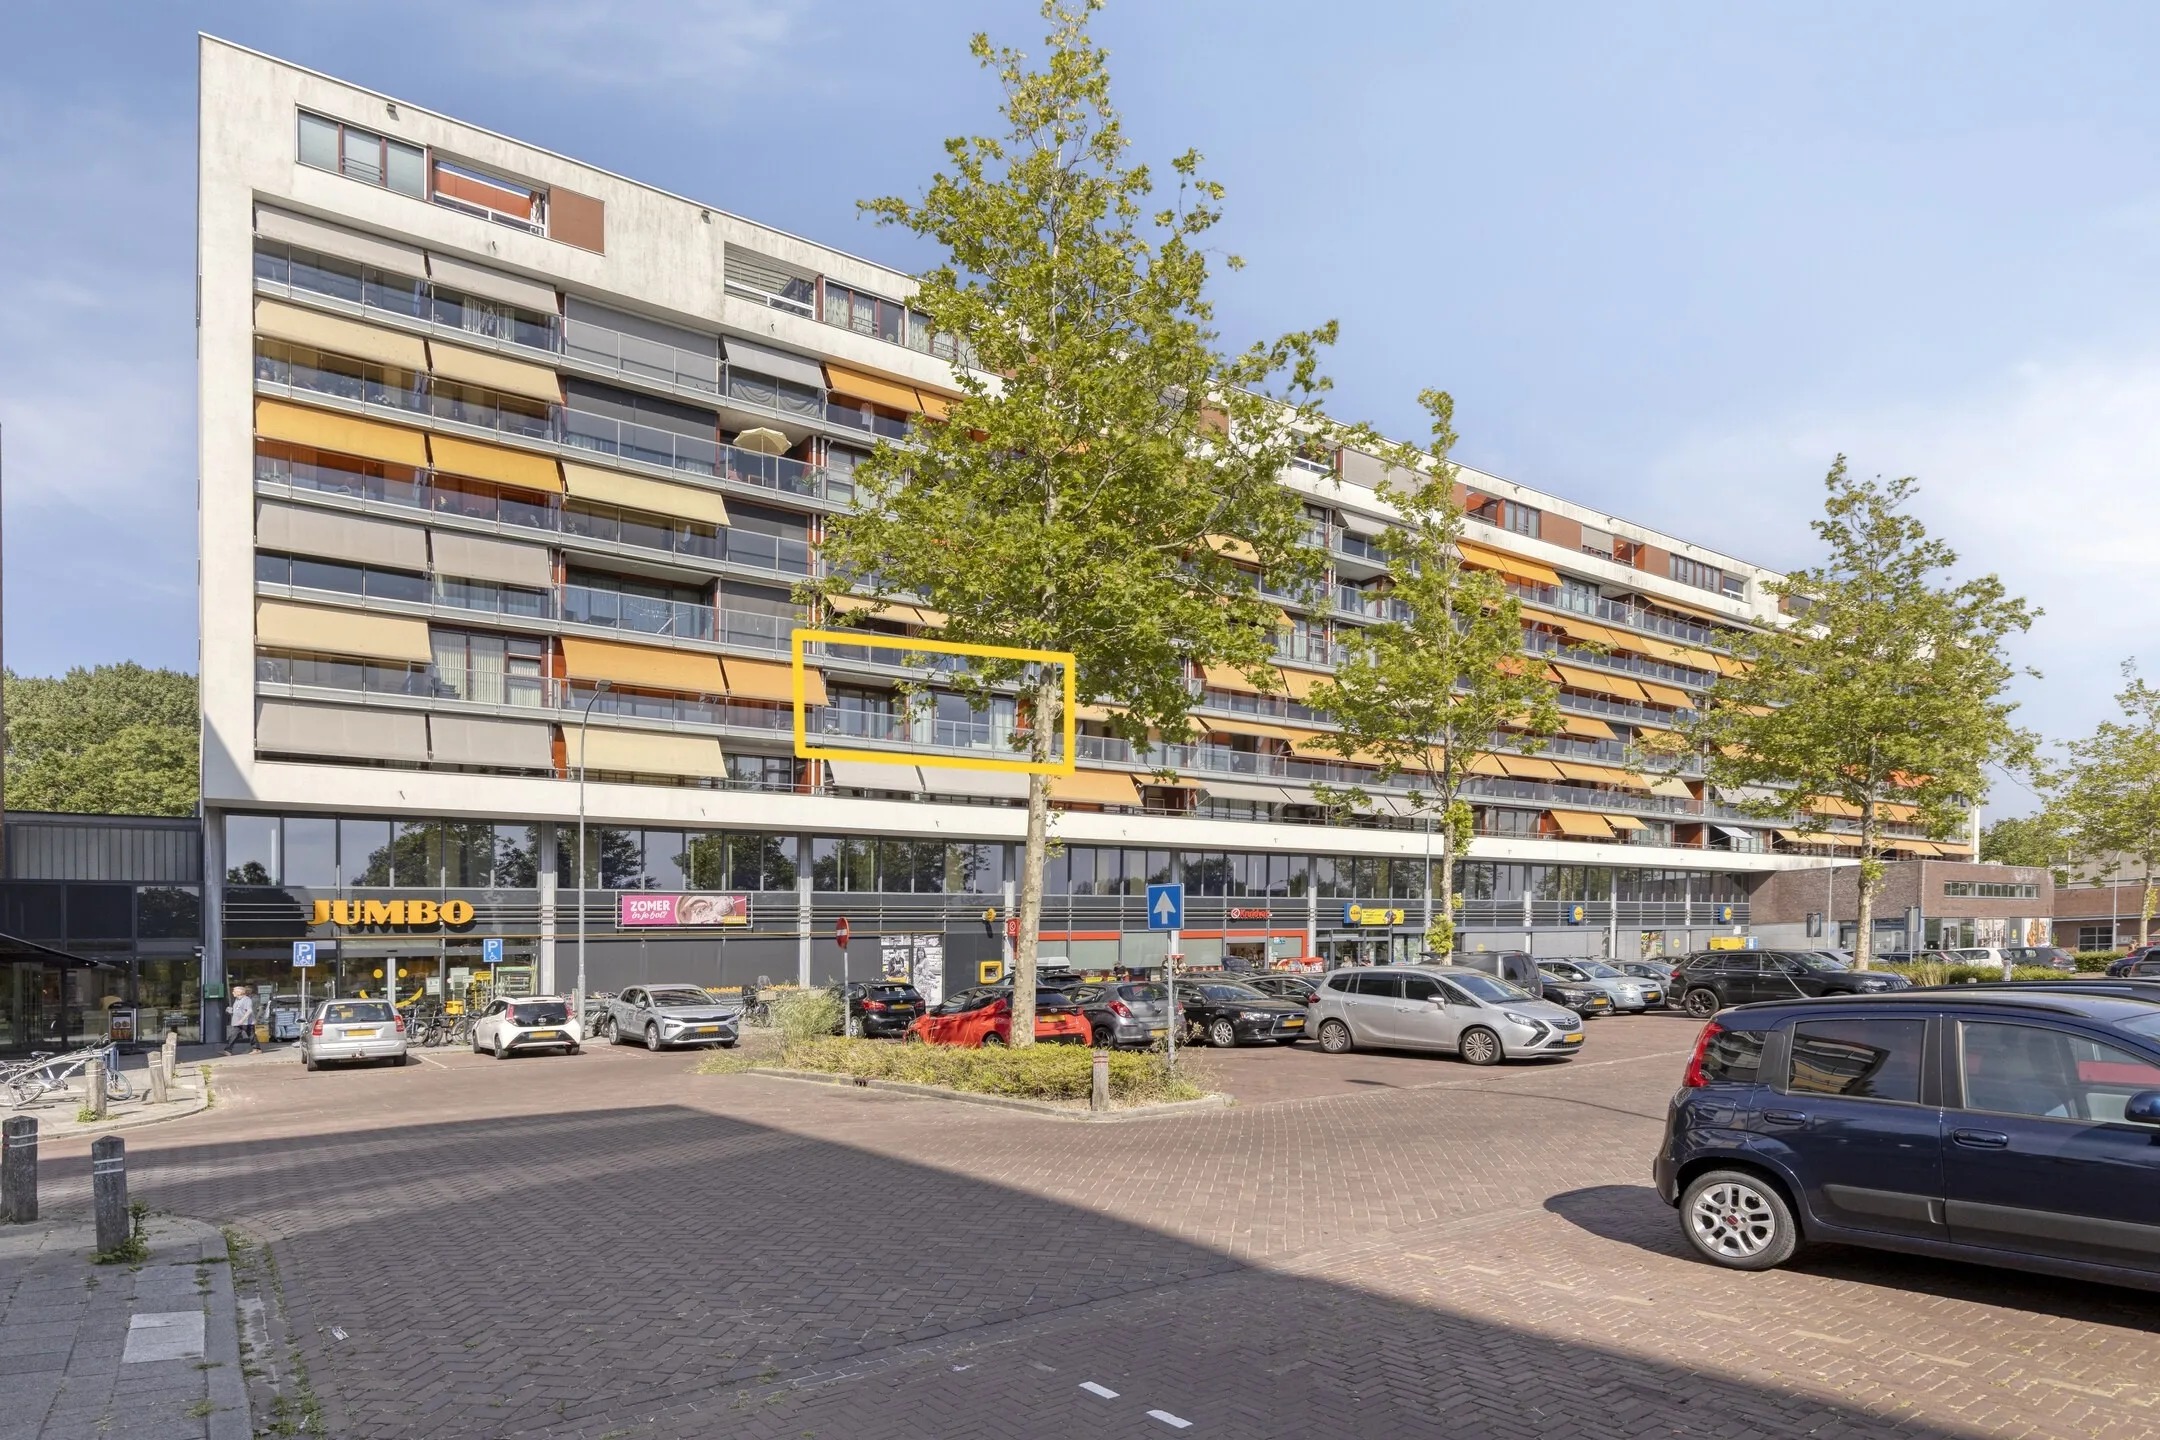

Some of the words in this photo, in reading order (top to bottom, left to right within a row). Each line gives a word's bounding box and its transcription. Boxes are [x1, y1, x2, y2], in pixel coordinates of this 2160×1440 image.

[307, 899, 474, 925] JUMBO
[630, 900, 670, 912] ZOMER
[640, 912, 649, 920] je
[299, 943, 310, 956] P
[488, 940, 498, 952] P
